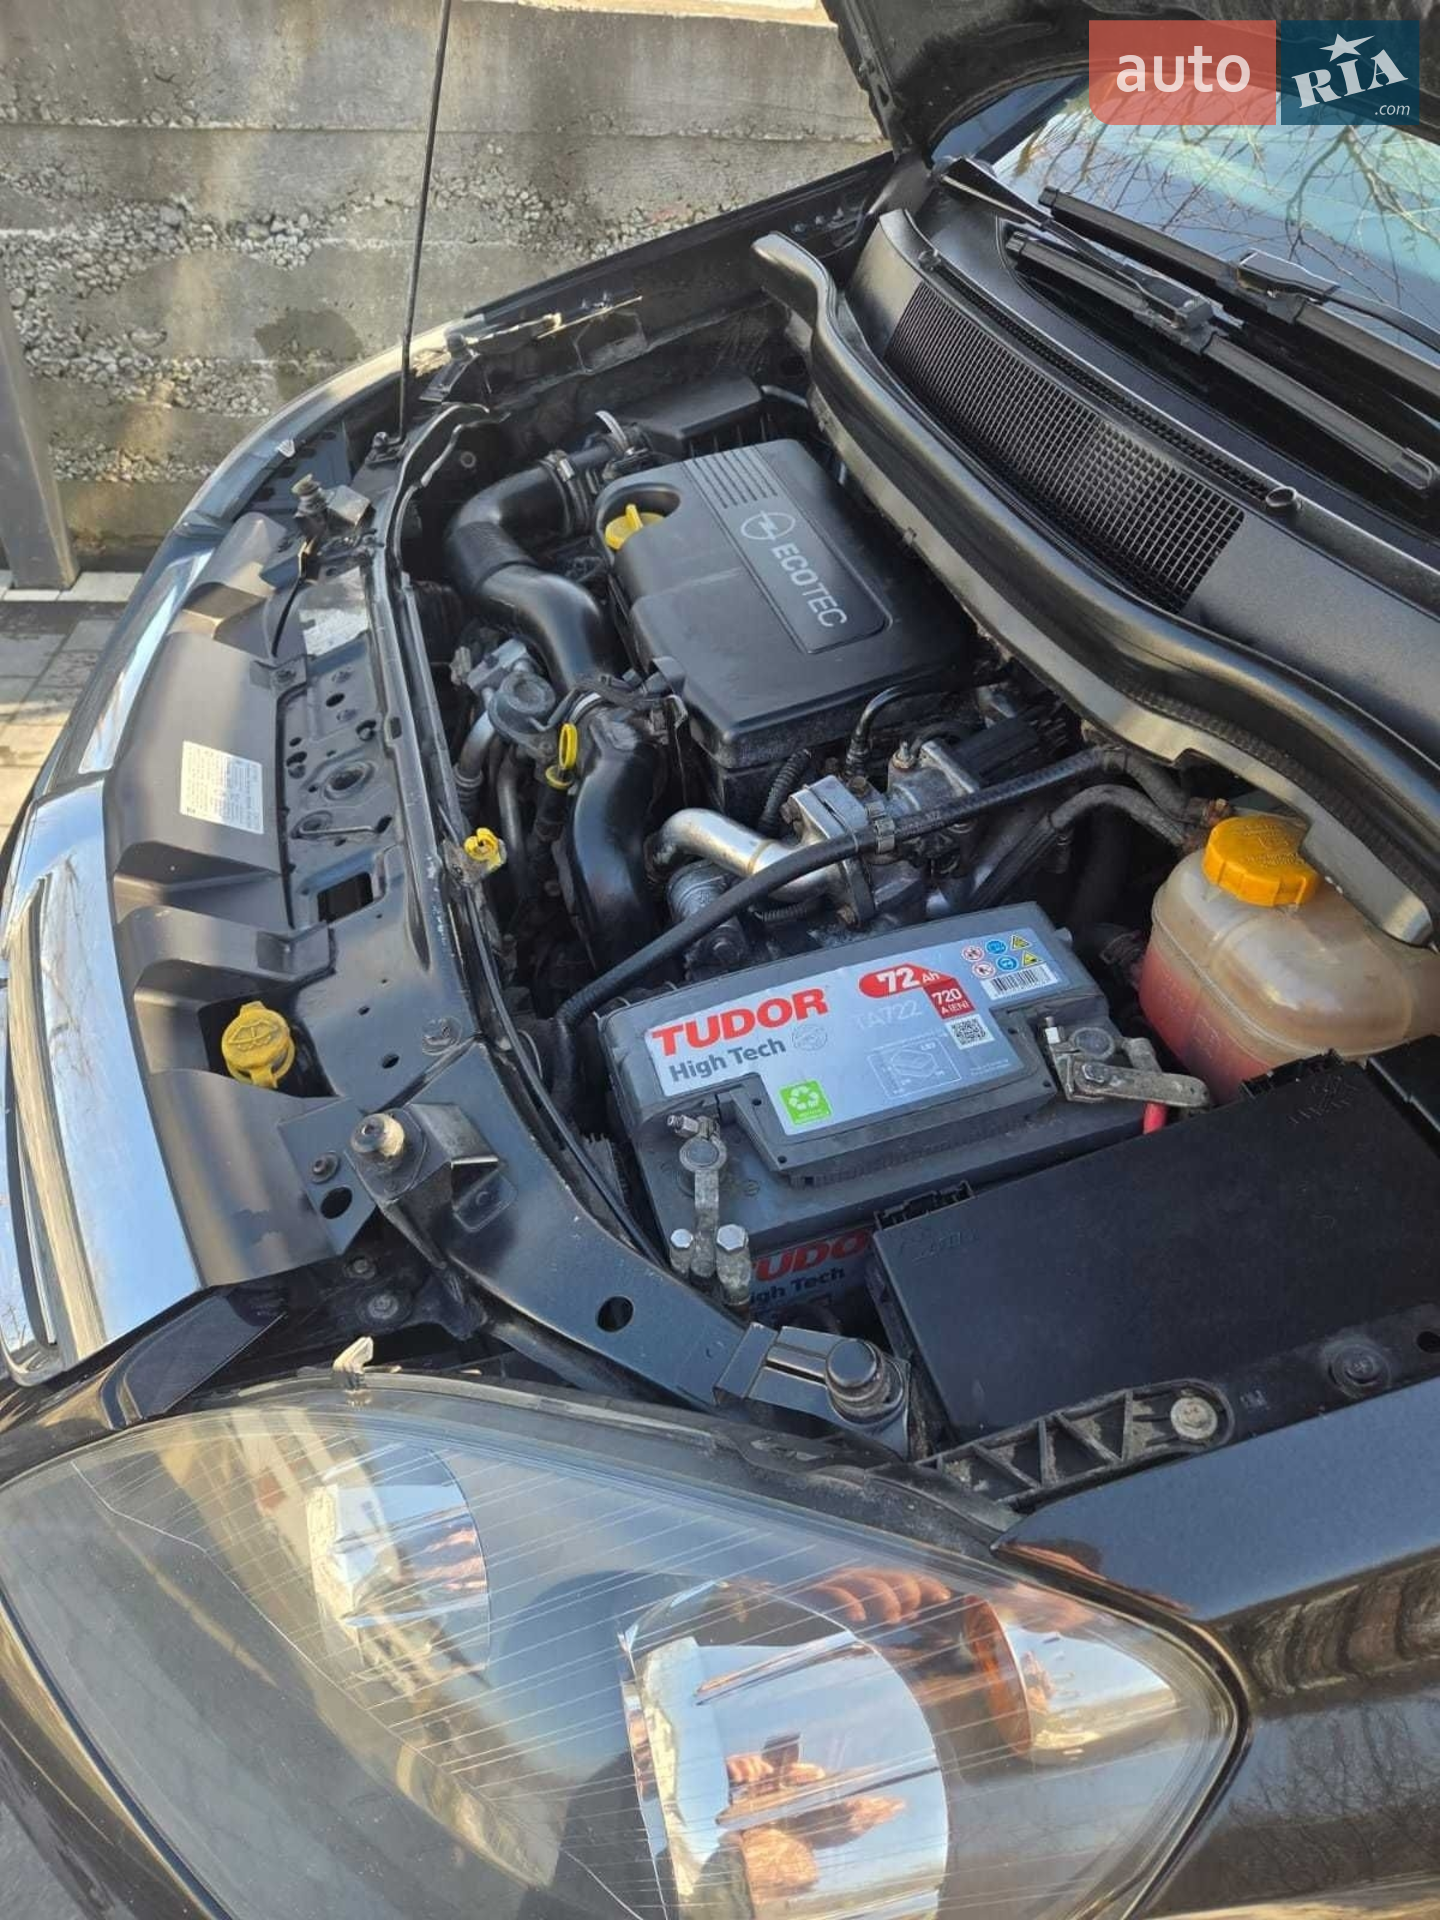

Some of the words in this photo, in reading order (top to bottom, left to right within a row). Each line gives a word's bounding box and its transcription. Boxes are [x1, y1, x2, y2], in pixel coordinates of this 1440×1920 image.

[771, 542, 848, 628] ECOTEC
[875, 967, 921, 993] 72
[922, 971, 940, 984] Ah
[932, 988, 962, 1005] 720
[650, 988, 829, 1058] TUDOR
[670, 1051, 727, 1085] High
[730, 1038, 788, 1068] Tech
[754, 1228, 869, 1280] UDO
[751, 1285, 785, 1304] igh
[790, 1266, 846, 1292] Tech
